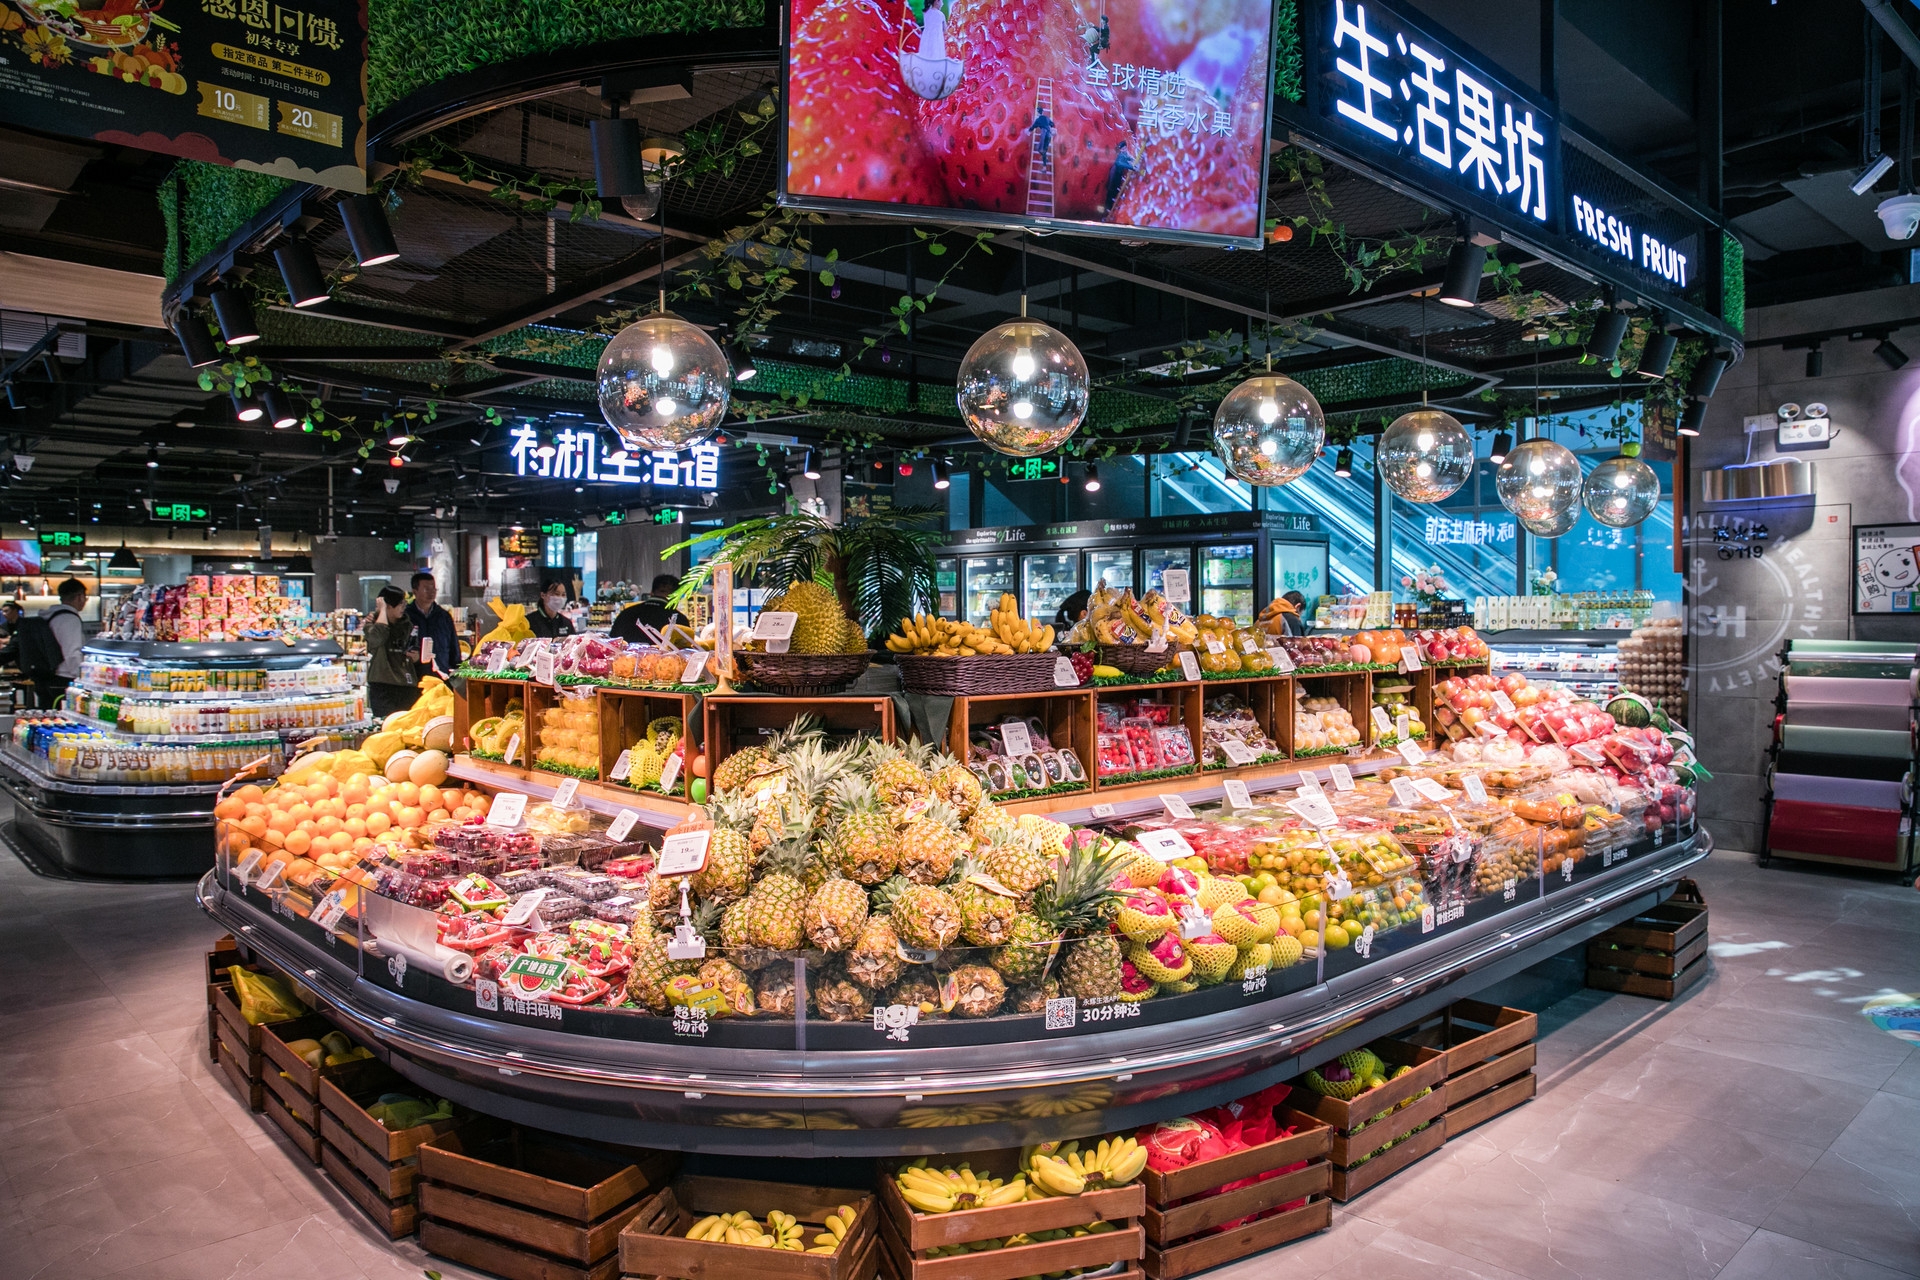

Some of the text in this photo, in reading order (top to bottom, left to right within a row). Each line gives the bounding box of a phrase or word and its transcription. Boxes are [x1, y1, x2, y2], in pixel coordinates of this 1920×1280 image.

[201, 0, 344, 51] 感恩回馈
[245, 30, 300, 56] 初冬专享
[223, 47, 325, 83] 指定商品 第二件半价
[1086, 58, 1186, 100] 全球精选
[1137, 99, 1233, 139] 当季水果
[1334, 0, 1548, 221] 生活果坊
[1574, 194, 1687, 288] FRESH FRUIT
[511, 424, 720, 488] 有机生活馆
[1005, 528, 1026, 542] Life
[1293, 516, 1311, 531] Life
[1736, 545, 1765, 558] 119
[1772, 534, 1824, 638] HEALTHY
[517, 959, 559, 977] 产地直采
[502, 996, 563, 1020] 微信扫码购
[673, 1004, 708, 1021] 超级
[1082, 1002, 1141, 1023] 30分钟达
[672, 1019, 709, 1038] 物种
